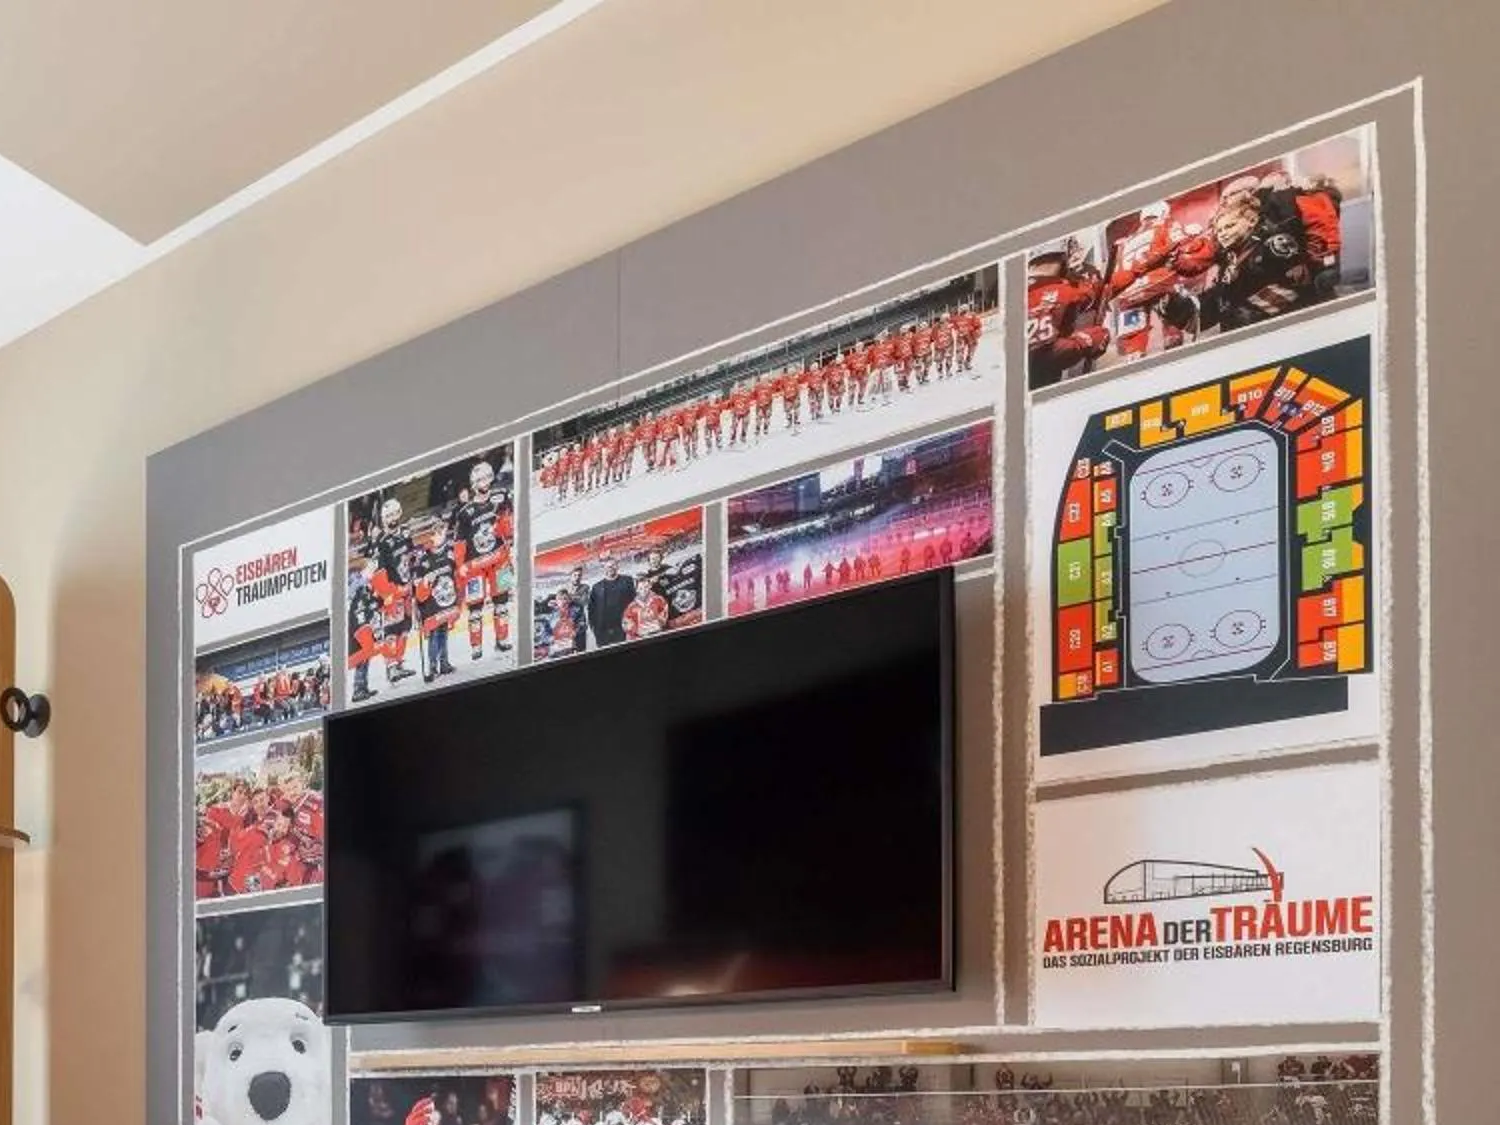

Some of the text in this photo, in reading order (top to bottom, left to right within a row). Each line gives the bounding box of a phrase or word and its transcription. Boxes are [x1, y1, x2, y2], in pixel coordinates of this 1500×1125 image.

[235, 560, 327, 607] TRAUMPFOTEN
[1043, 895, 1373, 952] ARENA DER TRÄUME
[1043, 955, 1067, 969] DAS
[1070, 949, 1171, 967] SOZIALPROJEKT
[1174, 947, 1199, 961] DER
[1275, 937, 1373, 956] REGENSBURG
